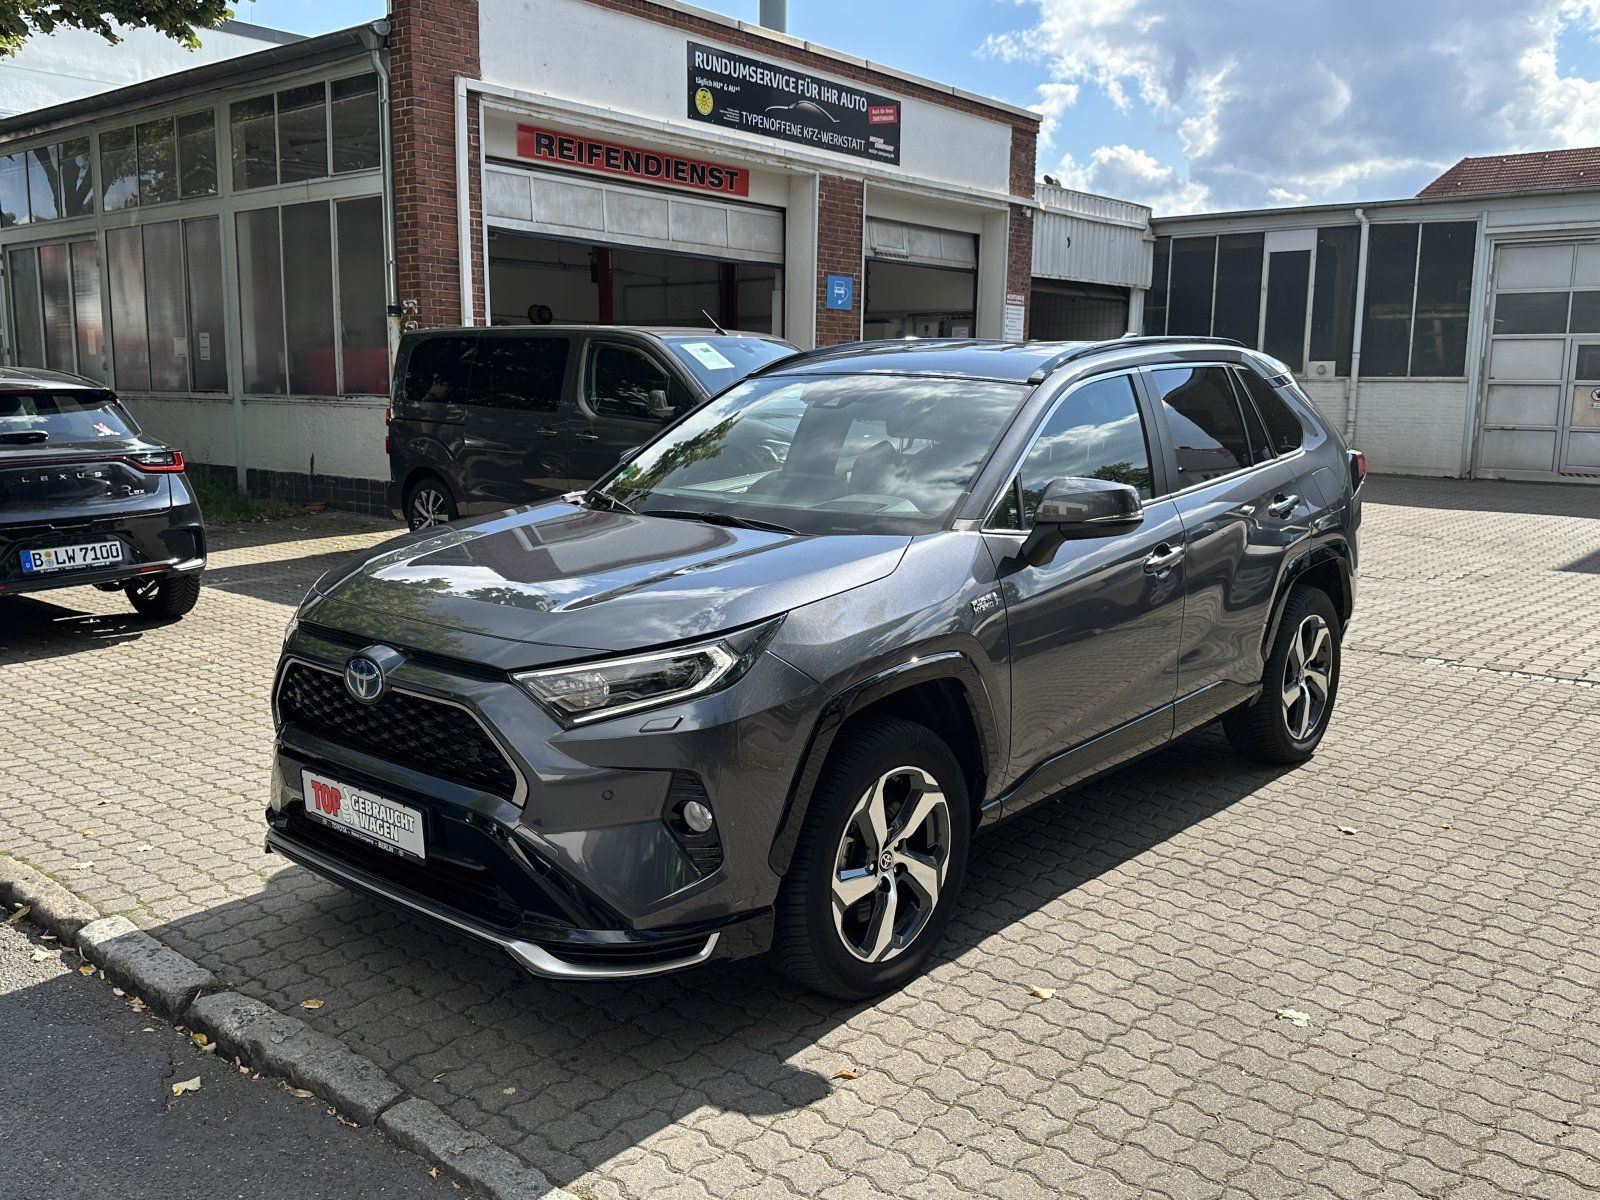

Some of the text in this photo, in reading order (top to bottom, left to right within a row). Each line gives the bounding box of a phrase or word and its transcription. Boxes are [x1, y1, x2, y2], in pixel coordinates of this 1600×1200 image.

[695, 51, 867, 112] RUNDUMSERVICE FÜR IHR AUTO
[741, 111, 802, 137] TYPENOFFENE
[803, 127, 865, 151] KFZ-WERKSTATT
[534, 132, 739, 191] REIFENDIENST
[22, 472, 102, 483] LEXUS
[32, 543, 120, 567] B LW 7100
[311, 780, 342, 817] TOP
[351, 794, 414, 833] GEBRAUCHT
[359, 813, 399, 842] WAGEN
